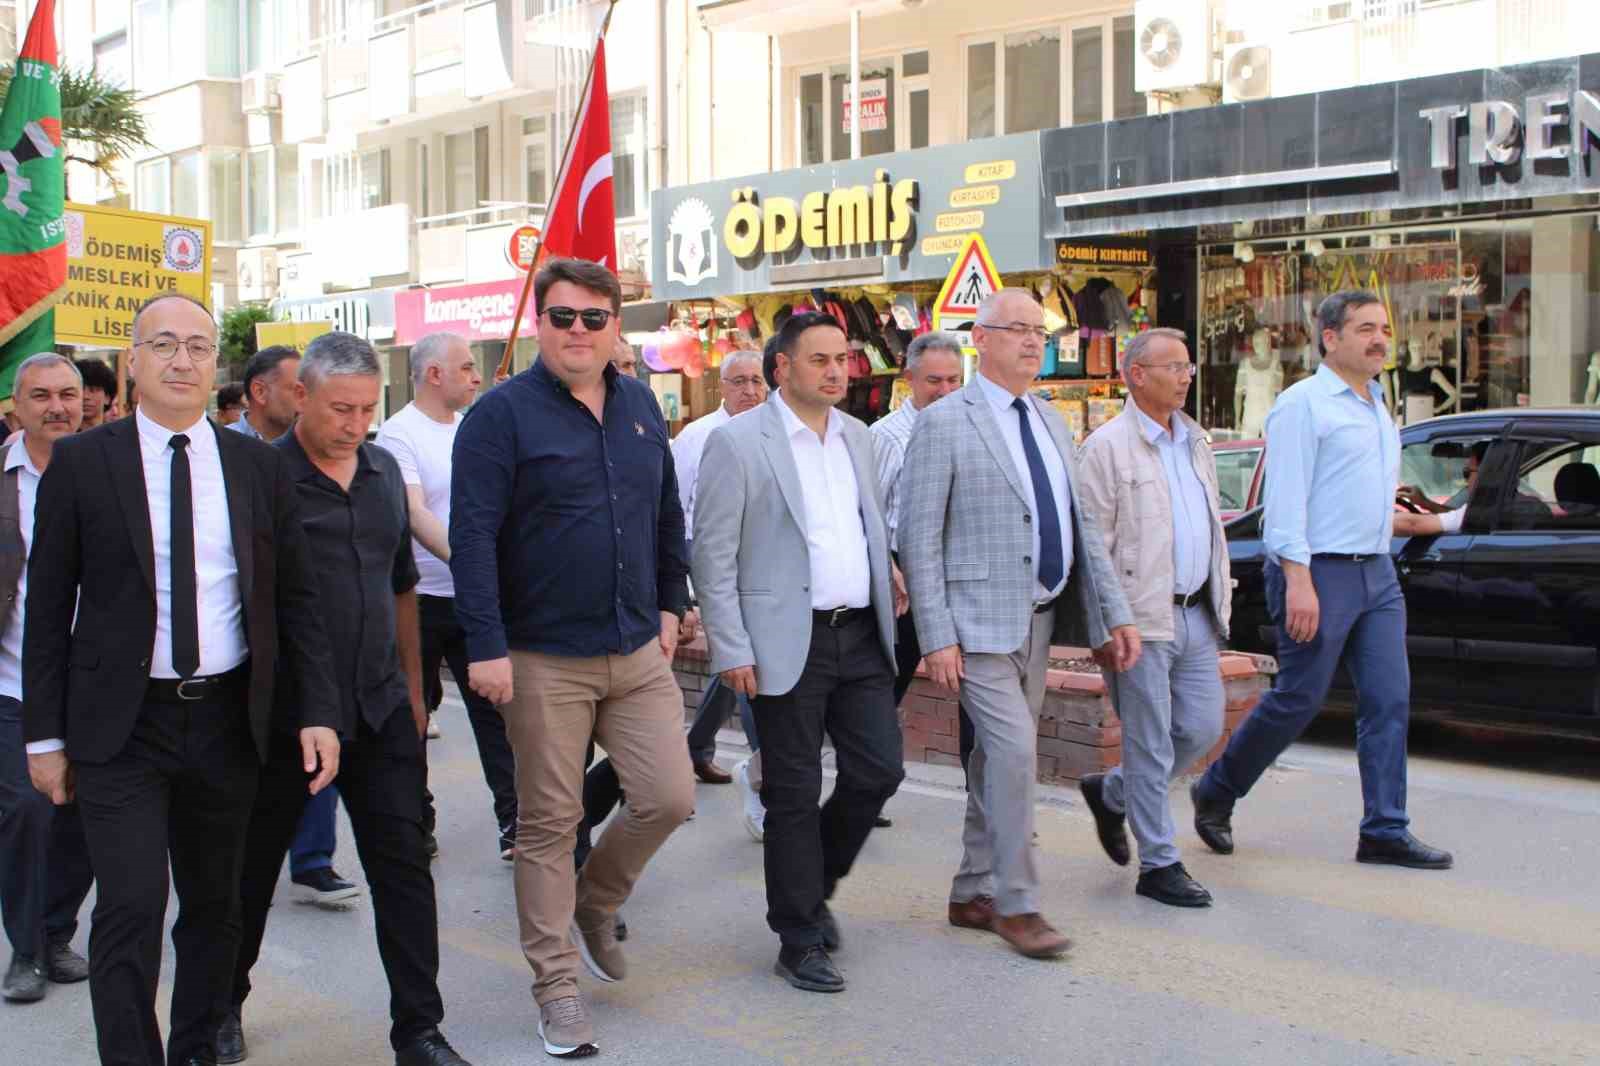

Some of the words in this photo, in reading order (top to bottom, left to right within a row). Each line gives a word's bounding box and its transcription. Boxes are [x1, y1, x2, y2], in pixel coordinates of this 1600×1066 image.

[724, 167, 919, 257] ÖDEMİŞ
[85, 236, 162, 268] ÖDEMİŞ
[68, 264, 150, 289] MESLEKİ
[155, 276, 178, 291] VE
[423, 291, 515, 330] komagene
